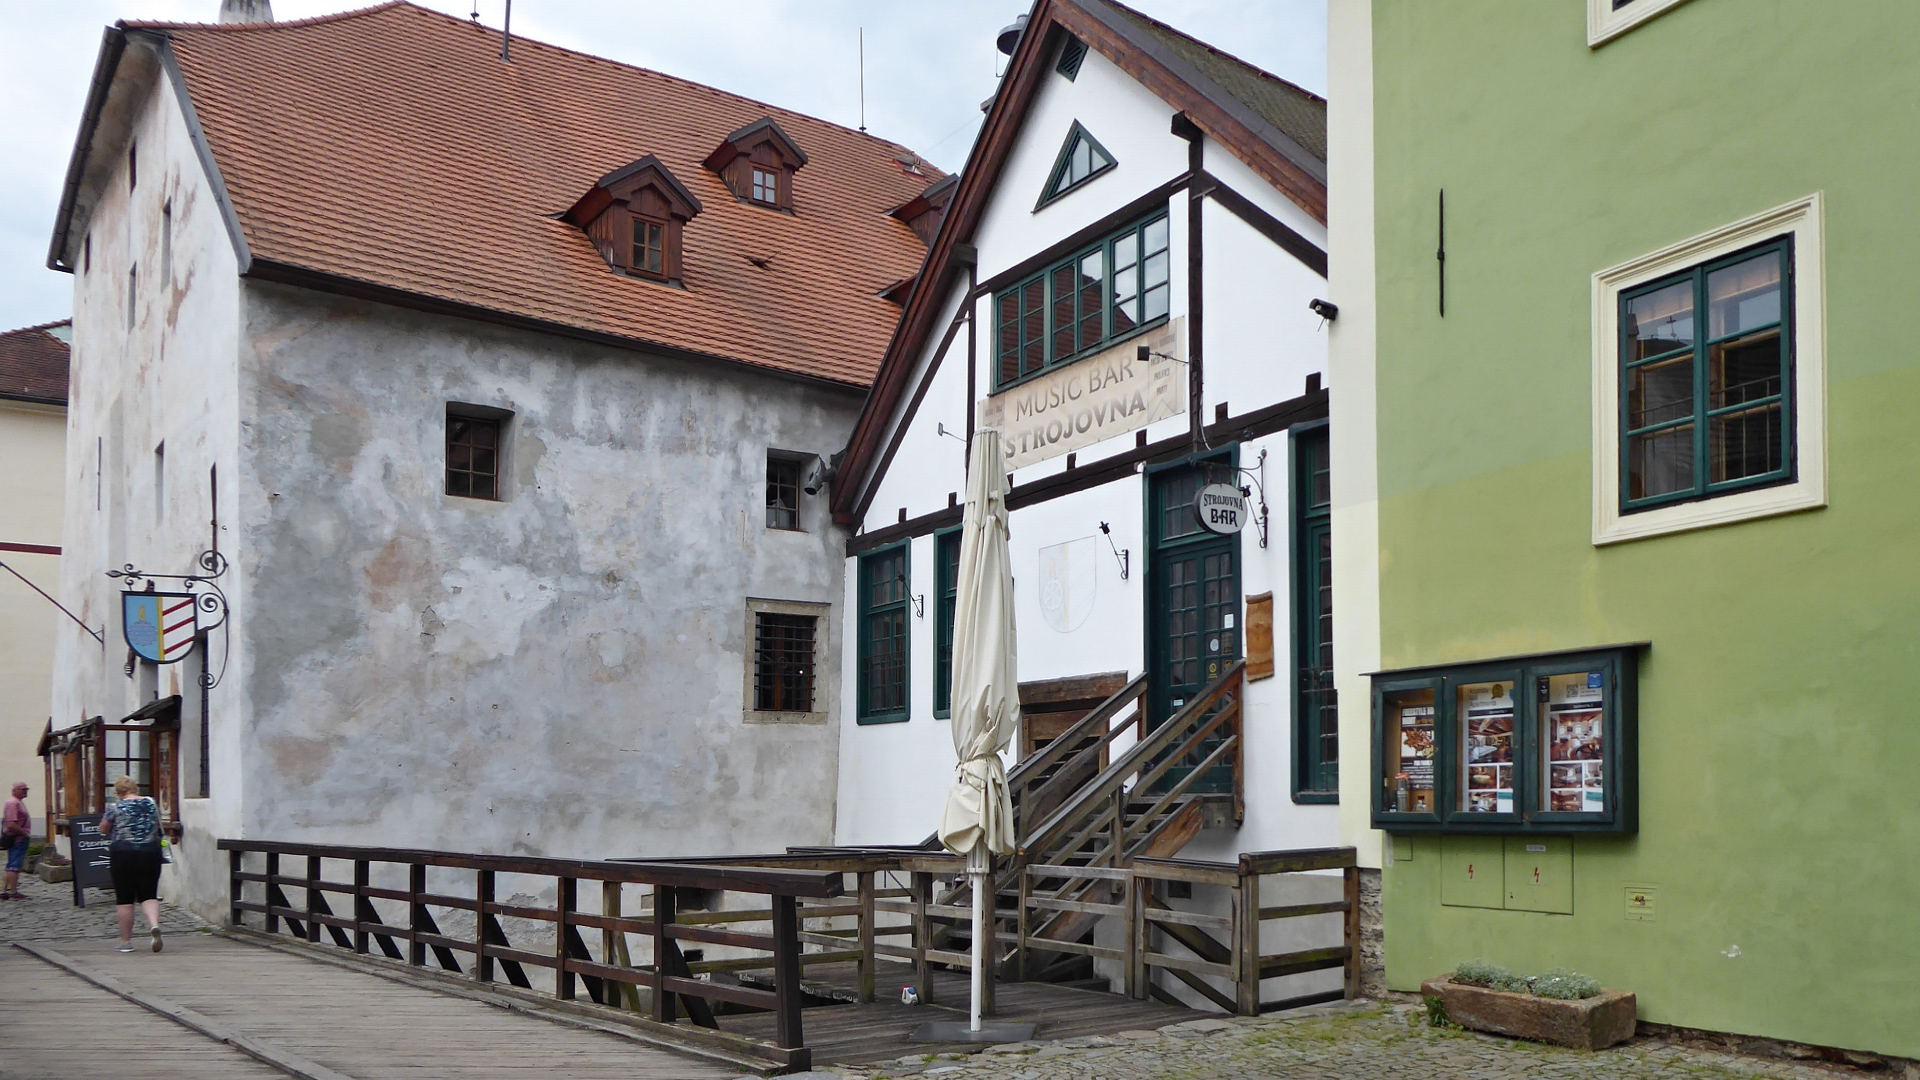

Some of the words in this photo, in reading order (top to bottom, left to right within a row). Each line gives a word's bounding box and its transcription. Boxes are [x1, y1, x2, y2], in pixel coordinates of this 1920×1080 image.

[1016, 376, 1082, 422] MUSIC
[1088, 355, 1134, 394] BAR
[1004, 389, 1146, 459] STROJOVNA
[1203, 493, 1243, 511] STROJOVNA
[1210, 508, 1238, 527] BAR
